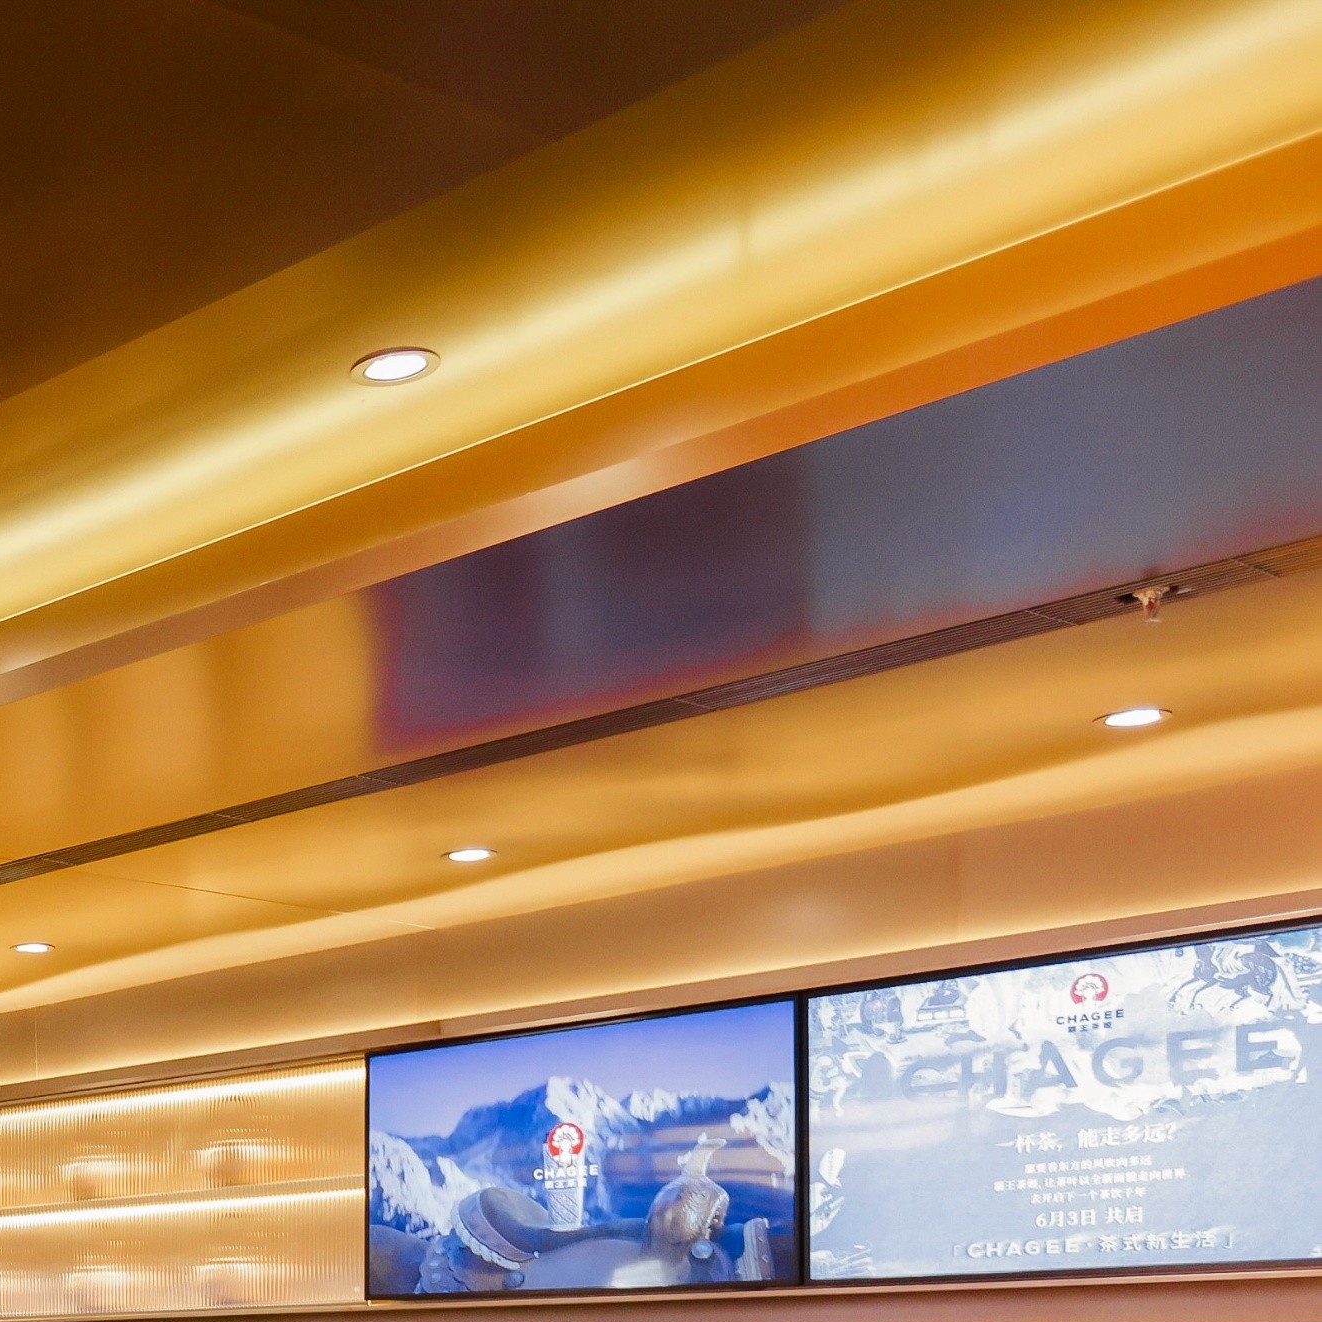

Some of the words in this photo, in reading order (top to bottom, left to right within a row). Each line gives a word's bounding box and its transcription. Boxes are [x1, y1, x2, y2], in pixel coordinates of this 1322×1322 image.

[1056, 1009, 1124, 1025] CHAGEE
[900, 1023, 1296, 1100] CHAGEE
[533, 1164, 600, 1181] CHAGEE
[1035, 1208, 1097, 1228] 6月3日
[1104, 1205, 1144, 1224] 共启
